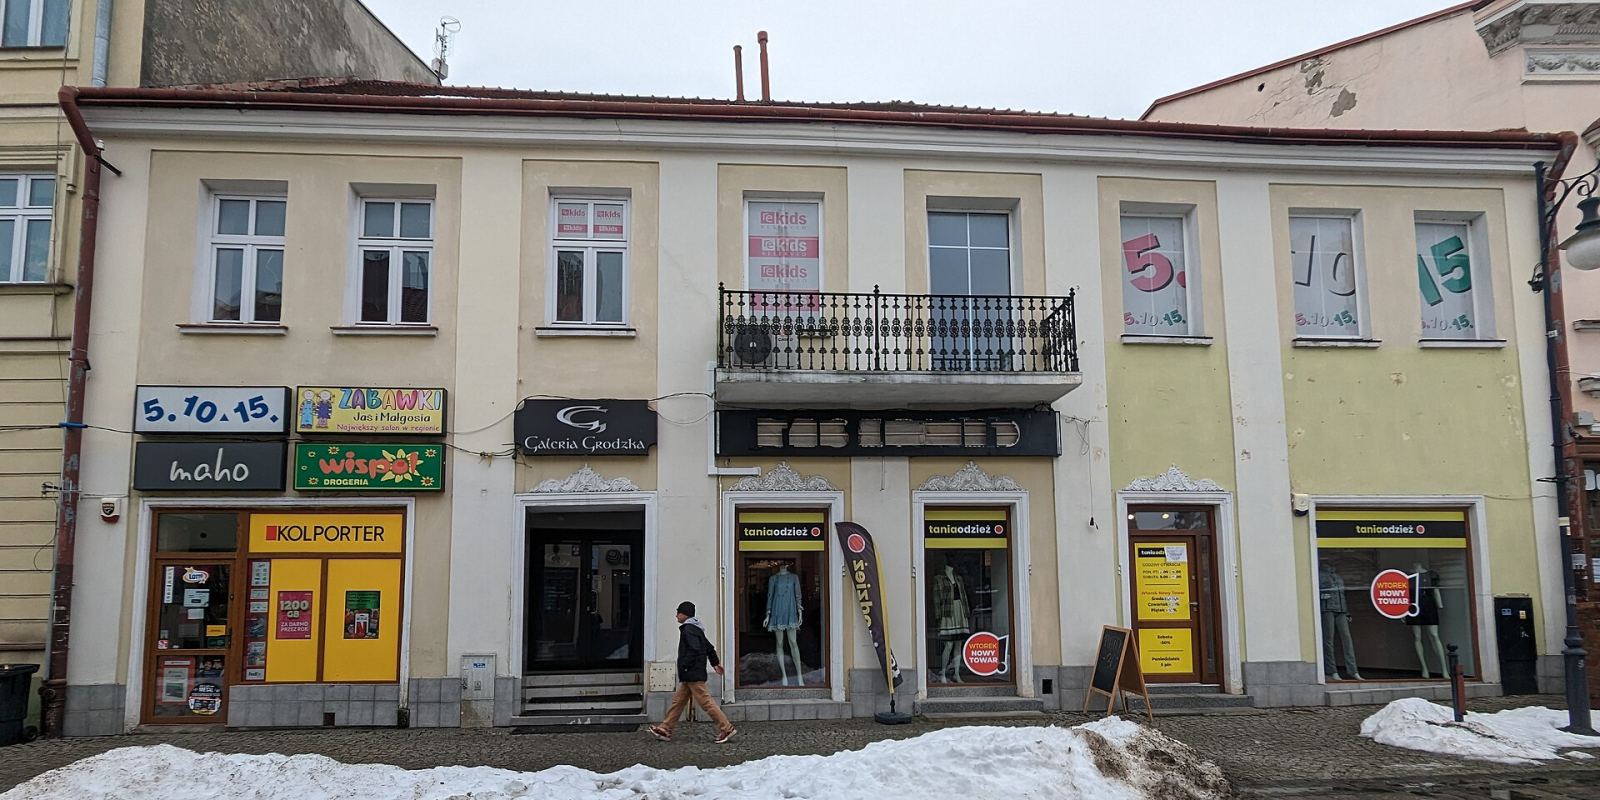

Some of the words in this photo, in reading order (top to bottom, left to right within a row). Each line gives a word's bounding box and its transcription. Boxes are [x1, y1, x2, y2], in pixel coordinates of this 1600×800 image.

[338, 388, 441, 410] ZABAWKI
[353, 412, 373, 421] Jaś
[375, 412, 379, 421] i
[336, 424, 378, 432] Największy
[410, 424, 440, 432] regionie
[169, 447, 249, 482] maho
[277, 525, 385, 541] KOLPORTER
[280, 600, 309, 610] 1200
[286, 610, 300, 618] GB
